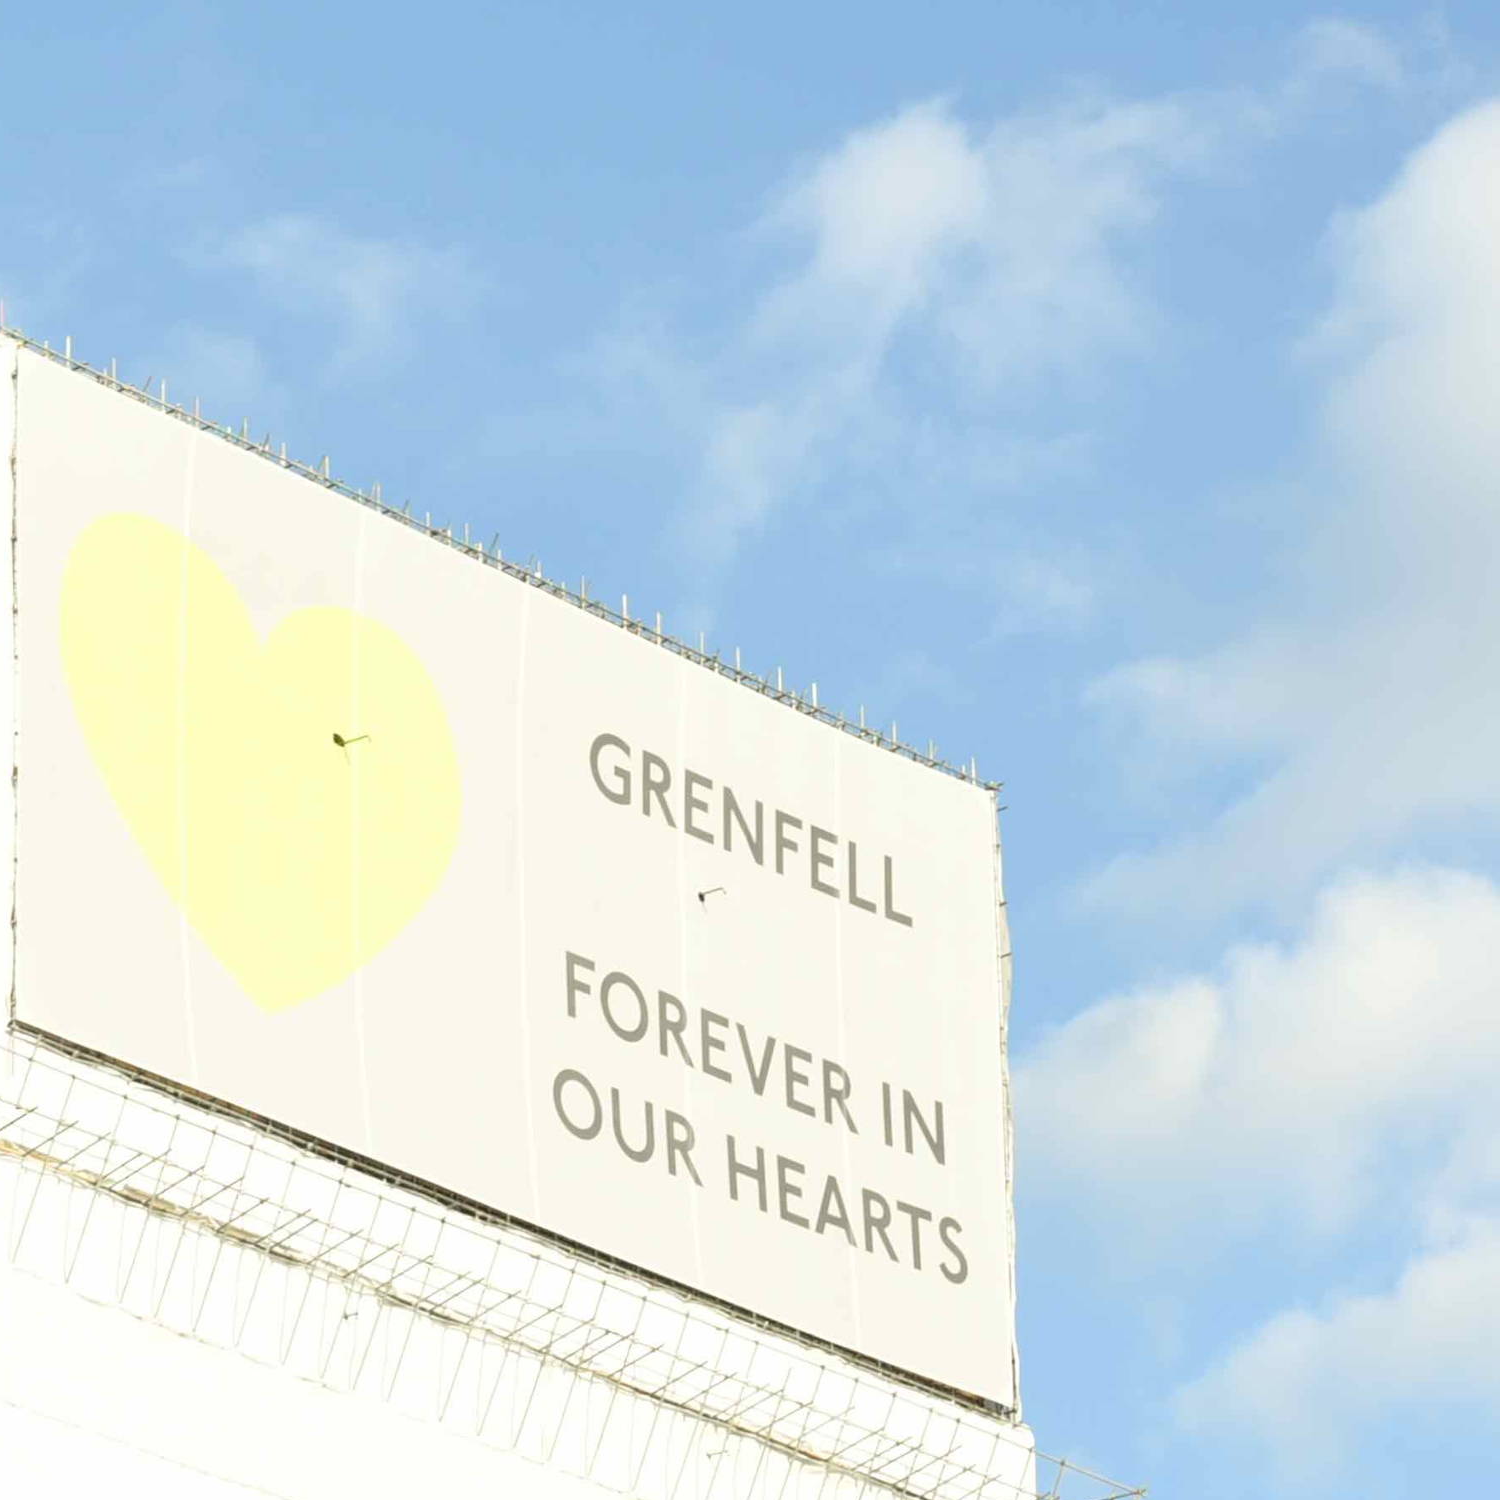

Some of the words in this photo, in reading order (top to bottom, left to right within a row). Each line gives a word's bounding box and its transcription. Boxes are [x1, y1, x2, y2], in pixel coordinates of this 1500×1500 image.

[589, 732, 913, 928] GRENFELL
[565, 950, 859, 1135] FOREVER
[882, 1081, 946, 1166] IN
[552, 1068, 703, 1187] OUR
[726, 1134, 969, 1285] HEARTS
